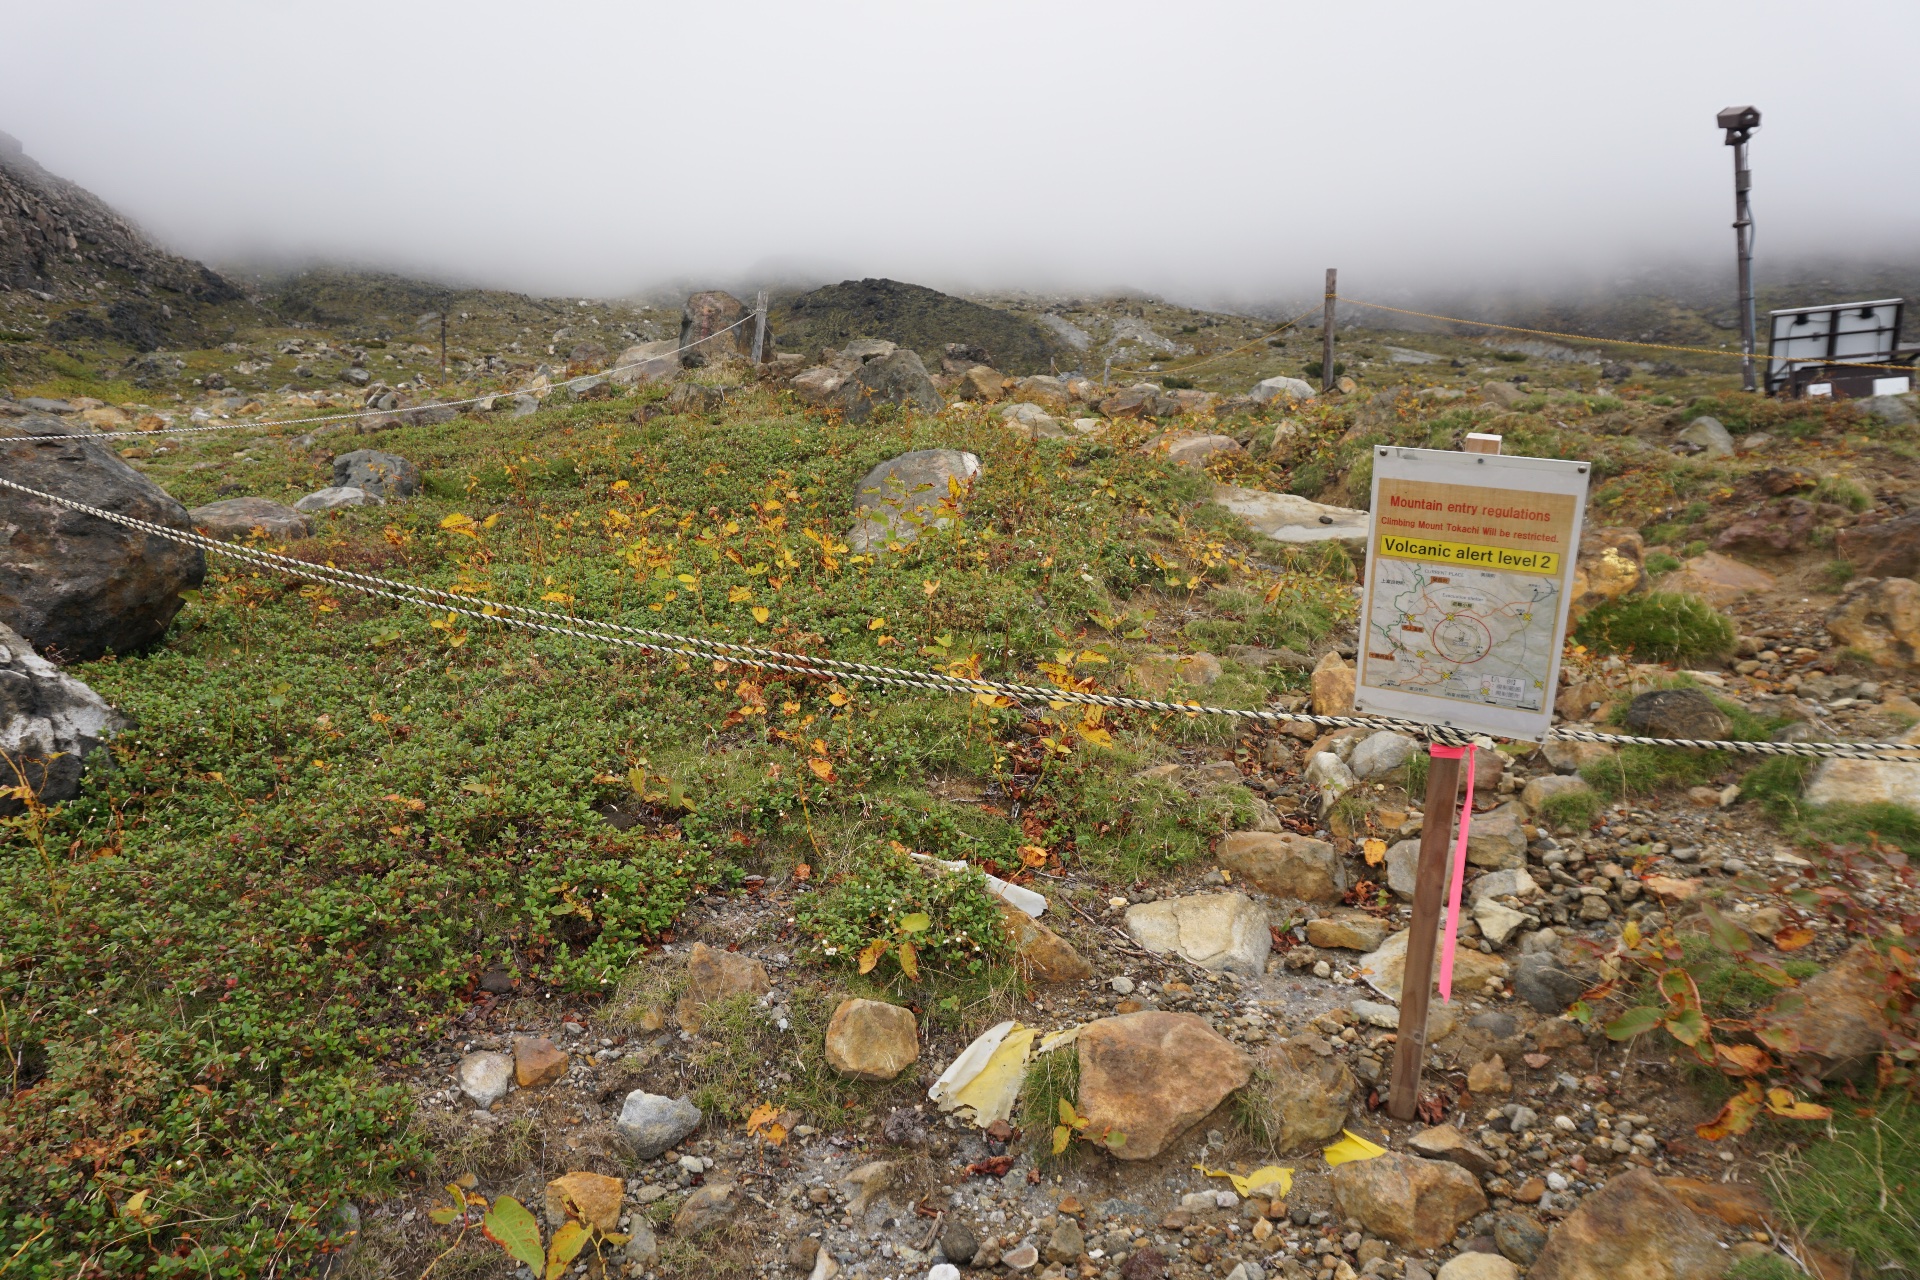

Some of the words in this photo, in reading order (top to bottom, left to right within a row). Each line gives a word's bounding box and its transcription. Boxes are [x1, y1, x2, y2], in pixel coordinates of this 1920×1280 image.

[1390, 495, 1443, 512] Mountain
[1447, 502, 1478, 516] entry
[1482, 505, 1551, 522] regulations
[1381, 516, 1415, 529] Climbing
[1418, 521, 1443, 531] Mount
[1447, 523, 1479, 534] Tokachi
[1482, 527, 1497, 537] Will
[1499, 529, 1510, 538] be
[1513, 530, 1559, 543] restricted.
[1384, 537, 1451, 558] Volcanic
[1456, 546, 1493, 563] alert
[1498, 551, 1537, 567] level
[1541, 555, 1551, 569] 2
